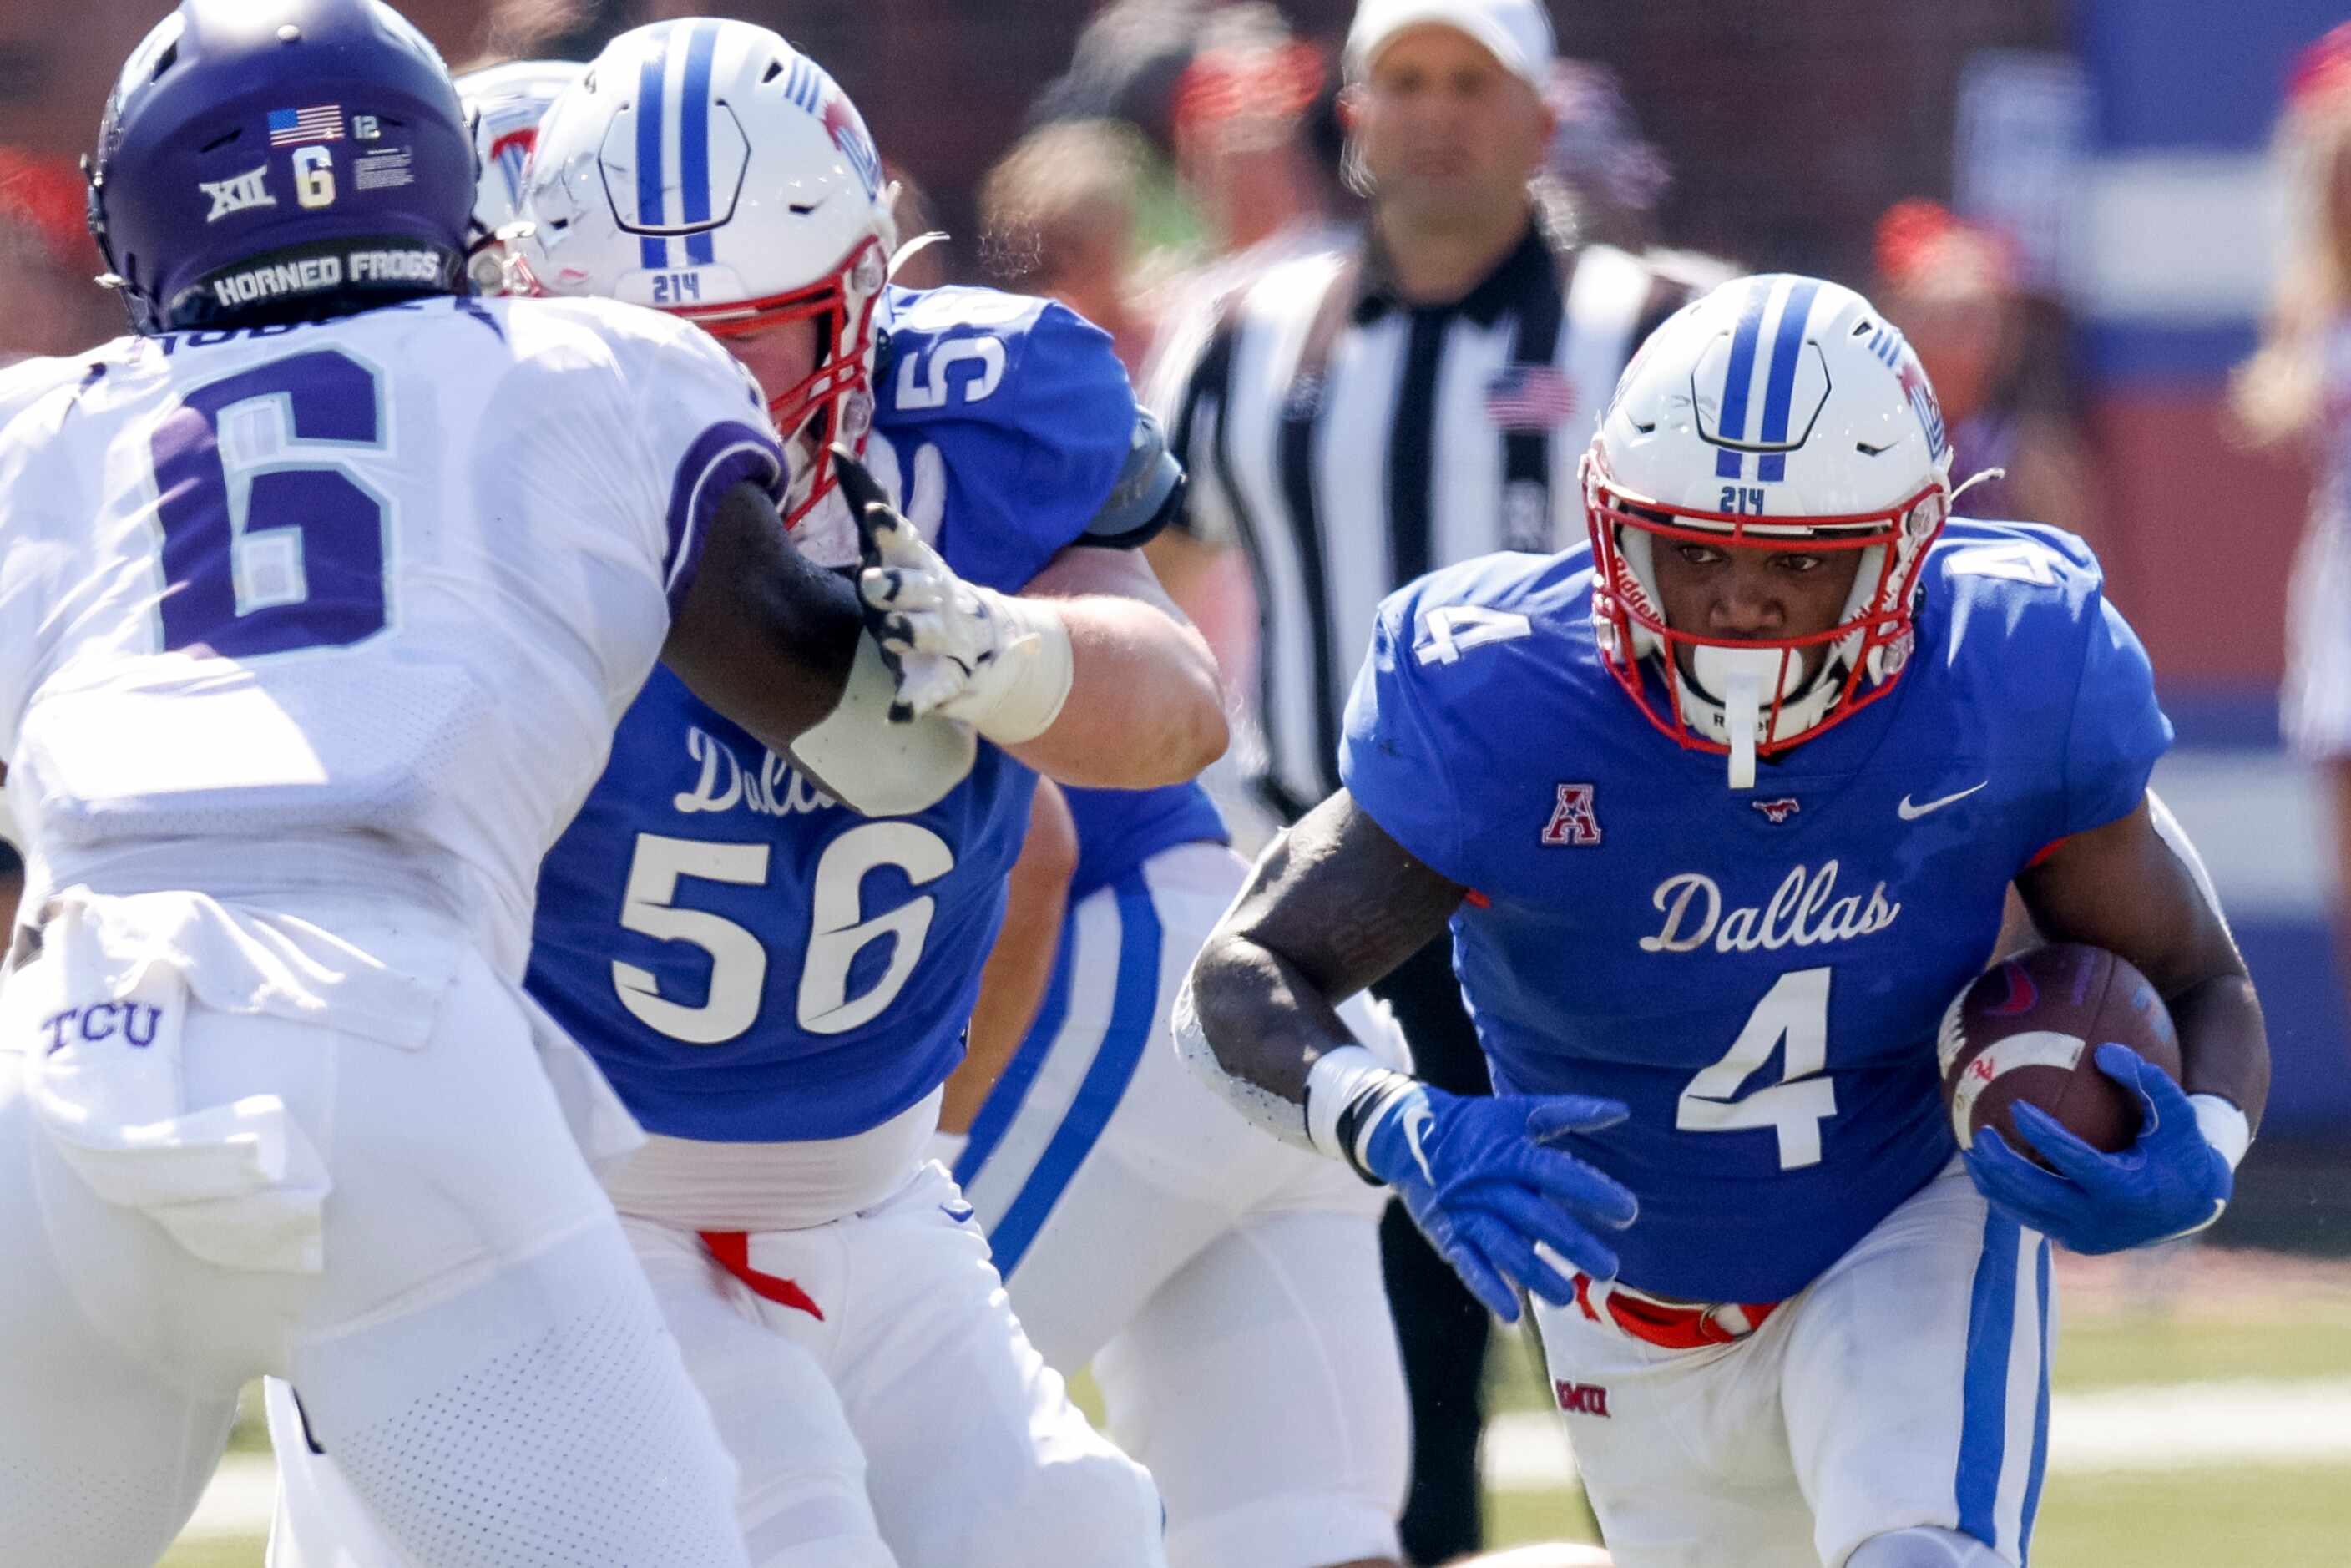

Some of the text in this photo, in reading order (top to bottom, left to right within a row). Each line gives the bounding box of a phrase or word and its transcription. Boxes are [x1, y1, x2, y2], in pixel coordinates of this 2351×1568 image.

[353, 114, 381, 140] 12
[199, 164, 276, 222] XII
[292, 145, 336, 209] 6
[214, 250, 442, 307] HORNED FROGS
[653, 272, 700, 302] 214
[147, 344, 396, 660] 6
[1720, 486, 1765, 516] 214
[1413, 605, 1532, 666] 4
[612, 822, 954, 1045] 56
[1639, 859, 1902, 953] Dallas
[41, 1002, 163, 1058] TCU
[1676, 966, 1838, 1170] 4
